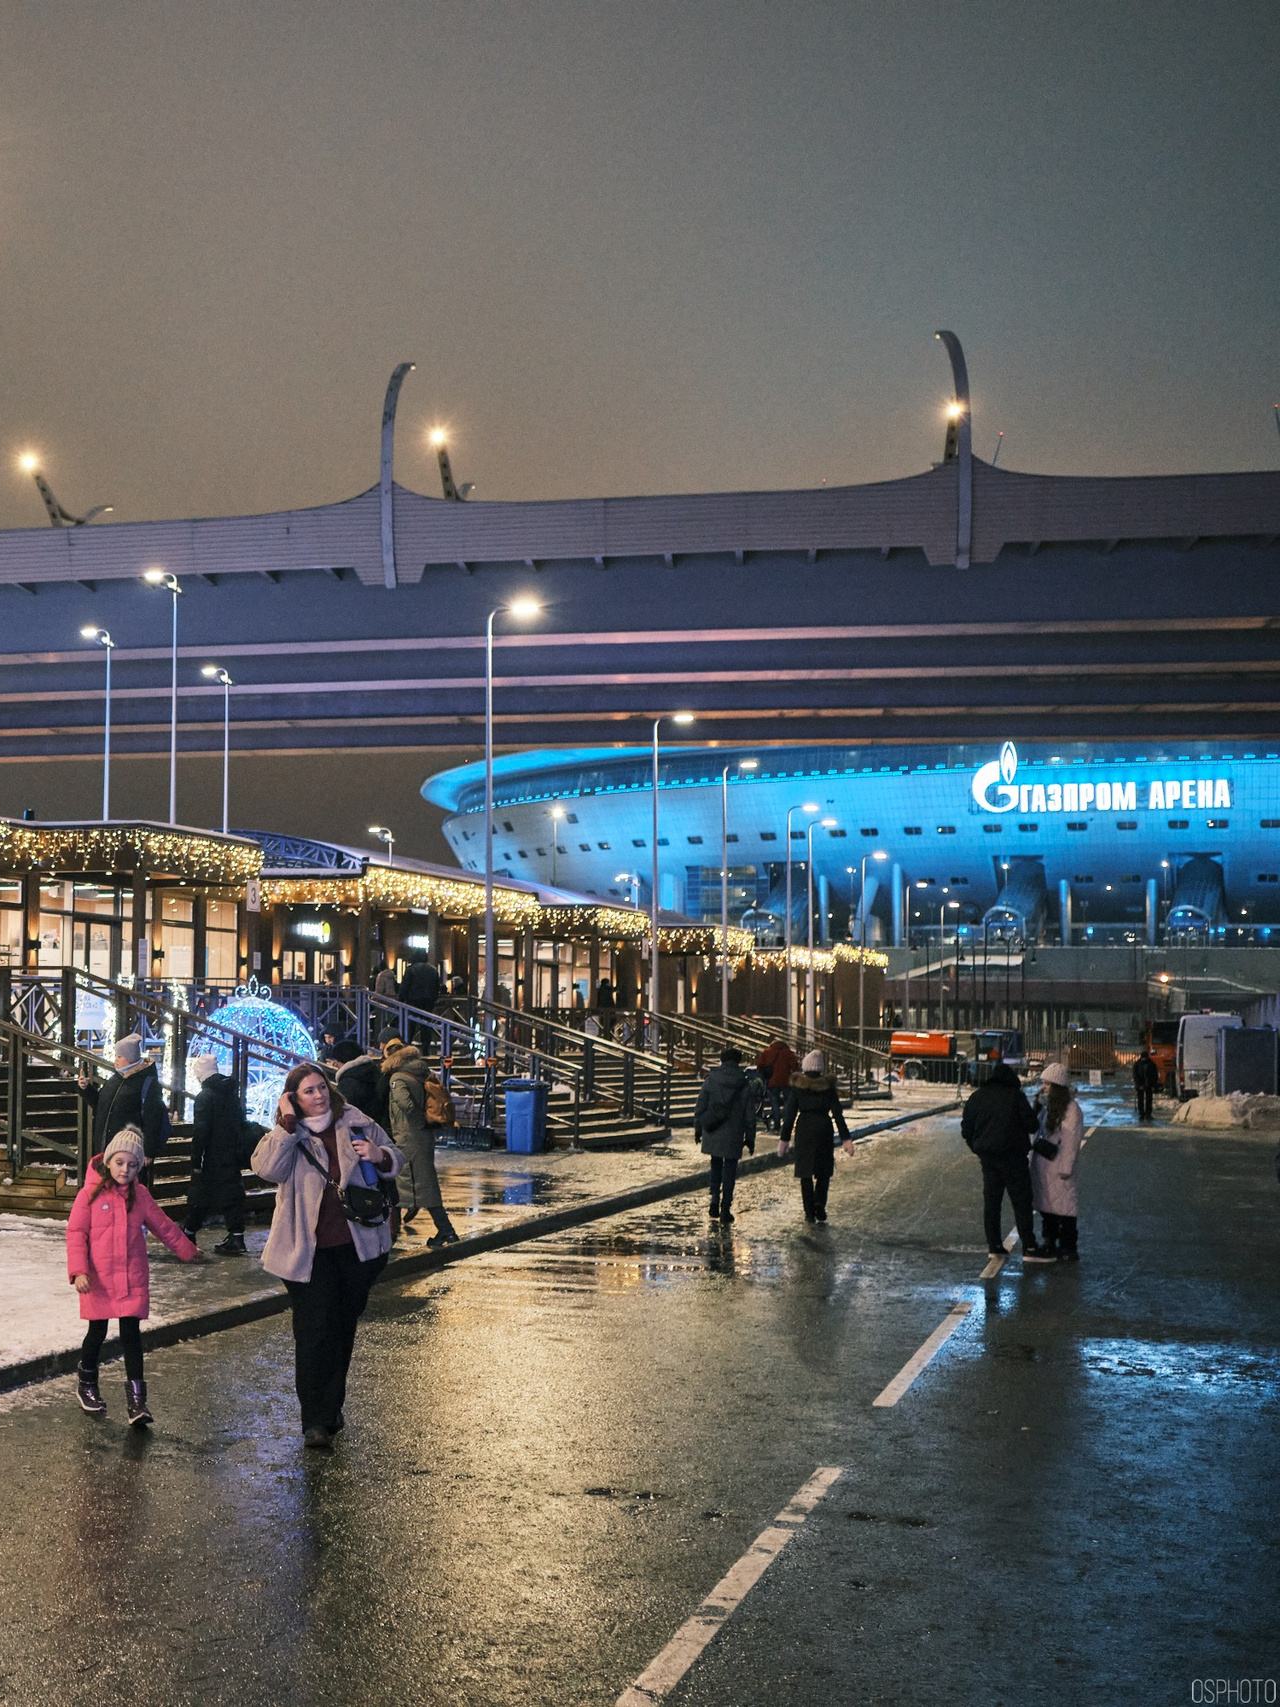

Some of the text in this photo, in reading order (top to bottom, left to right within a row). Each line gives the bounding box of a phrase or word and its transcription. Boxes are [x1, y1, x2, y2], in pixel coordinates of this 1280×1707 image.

[1019, 781, 1136, 813] ГАЗПРОМ
[1148, 779, 1231, 810] АРЕНА
[250, 887, 257, 904] 3
